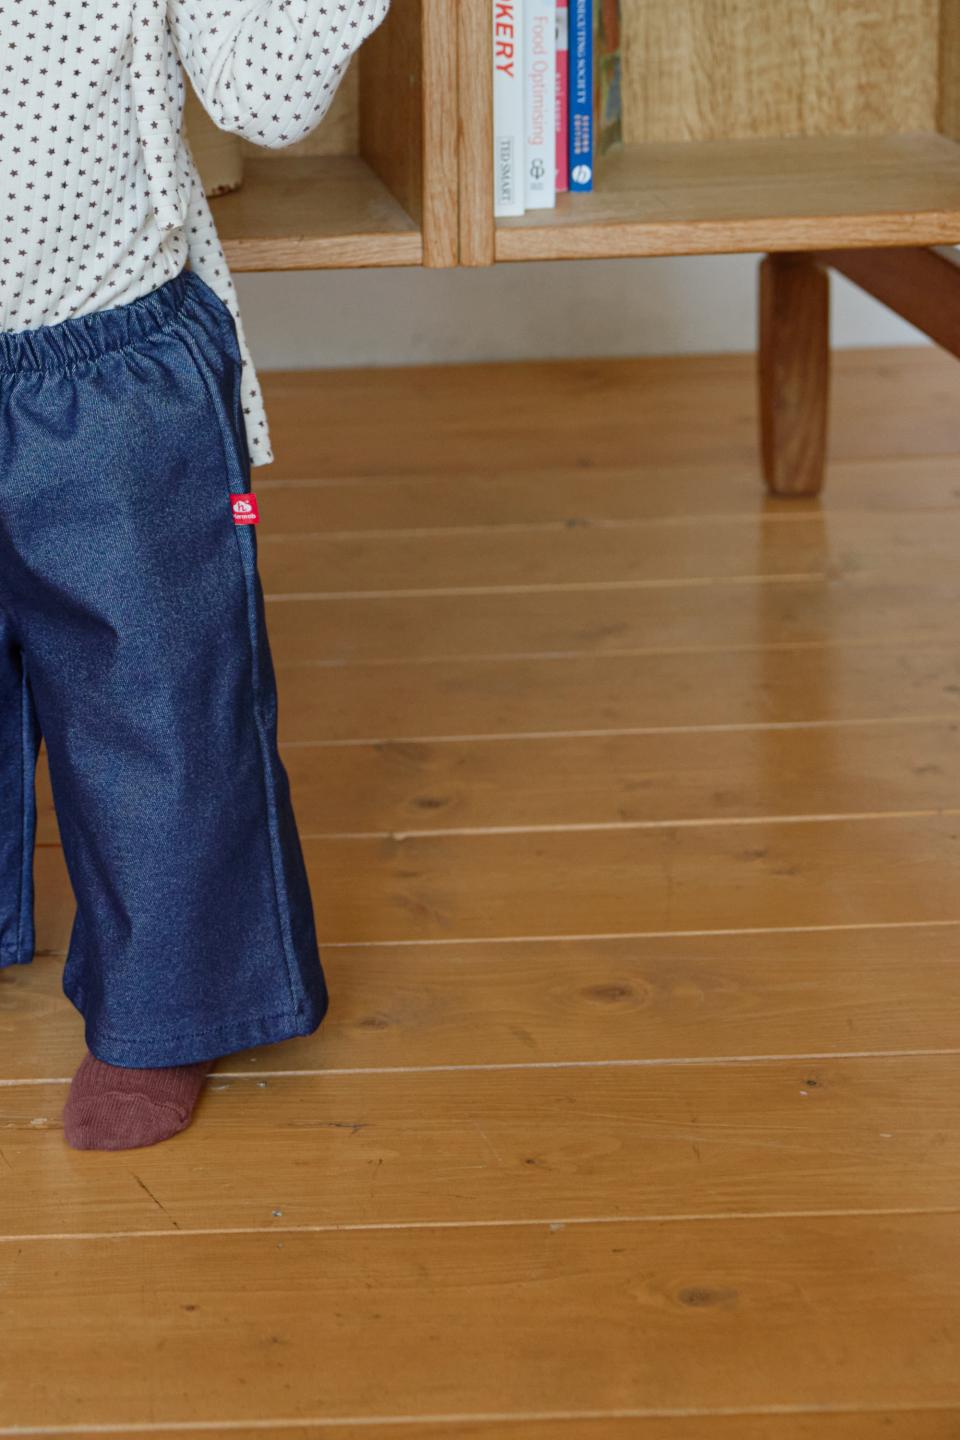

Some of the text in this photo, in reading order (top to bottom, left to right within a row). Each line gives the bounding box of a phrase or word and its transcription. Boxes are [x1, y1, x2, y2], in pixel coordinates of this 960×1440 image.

[528, 16, 548, 145] Food Optimising
[576, 59, 586, 104] SOCIETY
[500, 140, 511, 202] TED SMART
